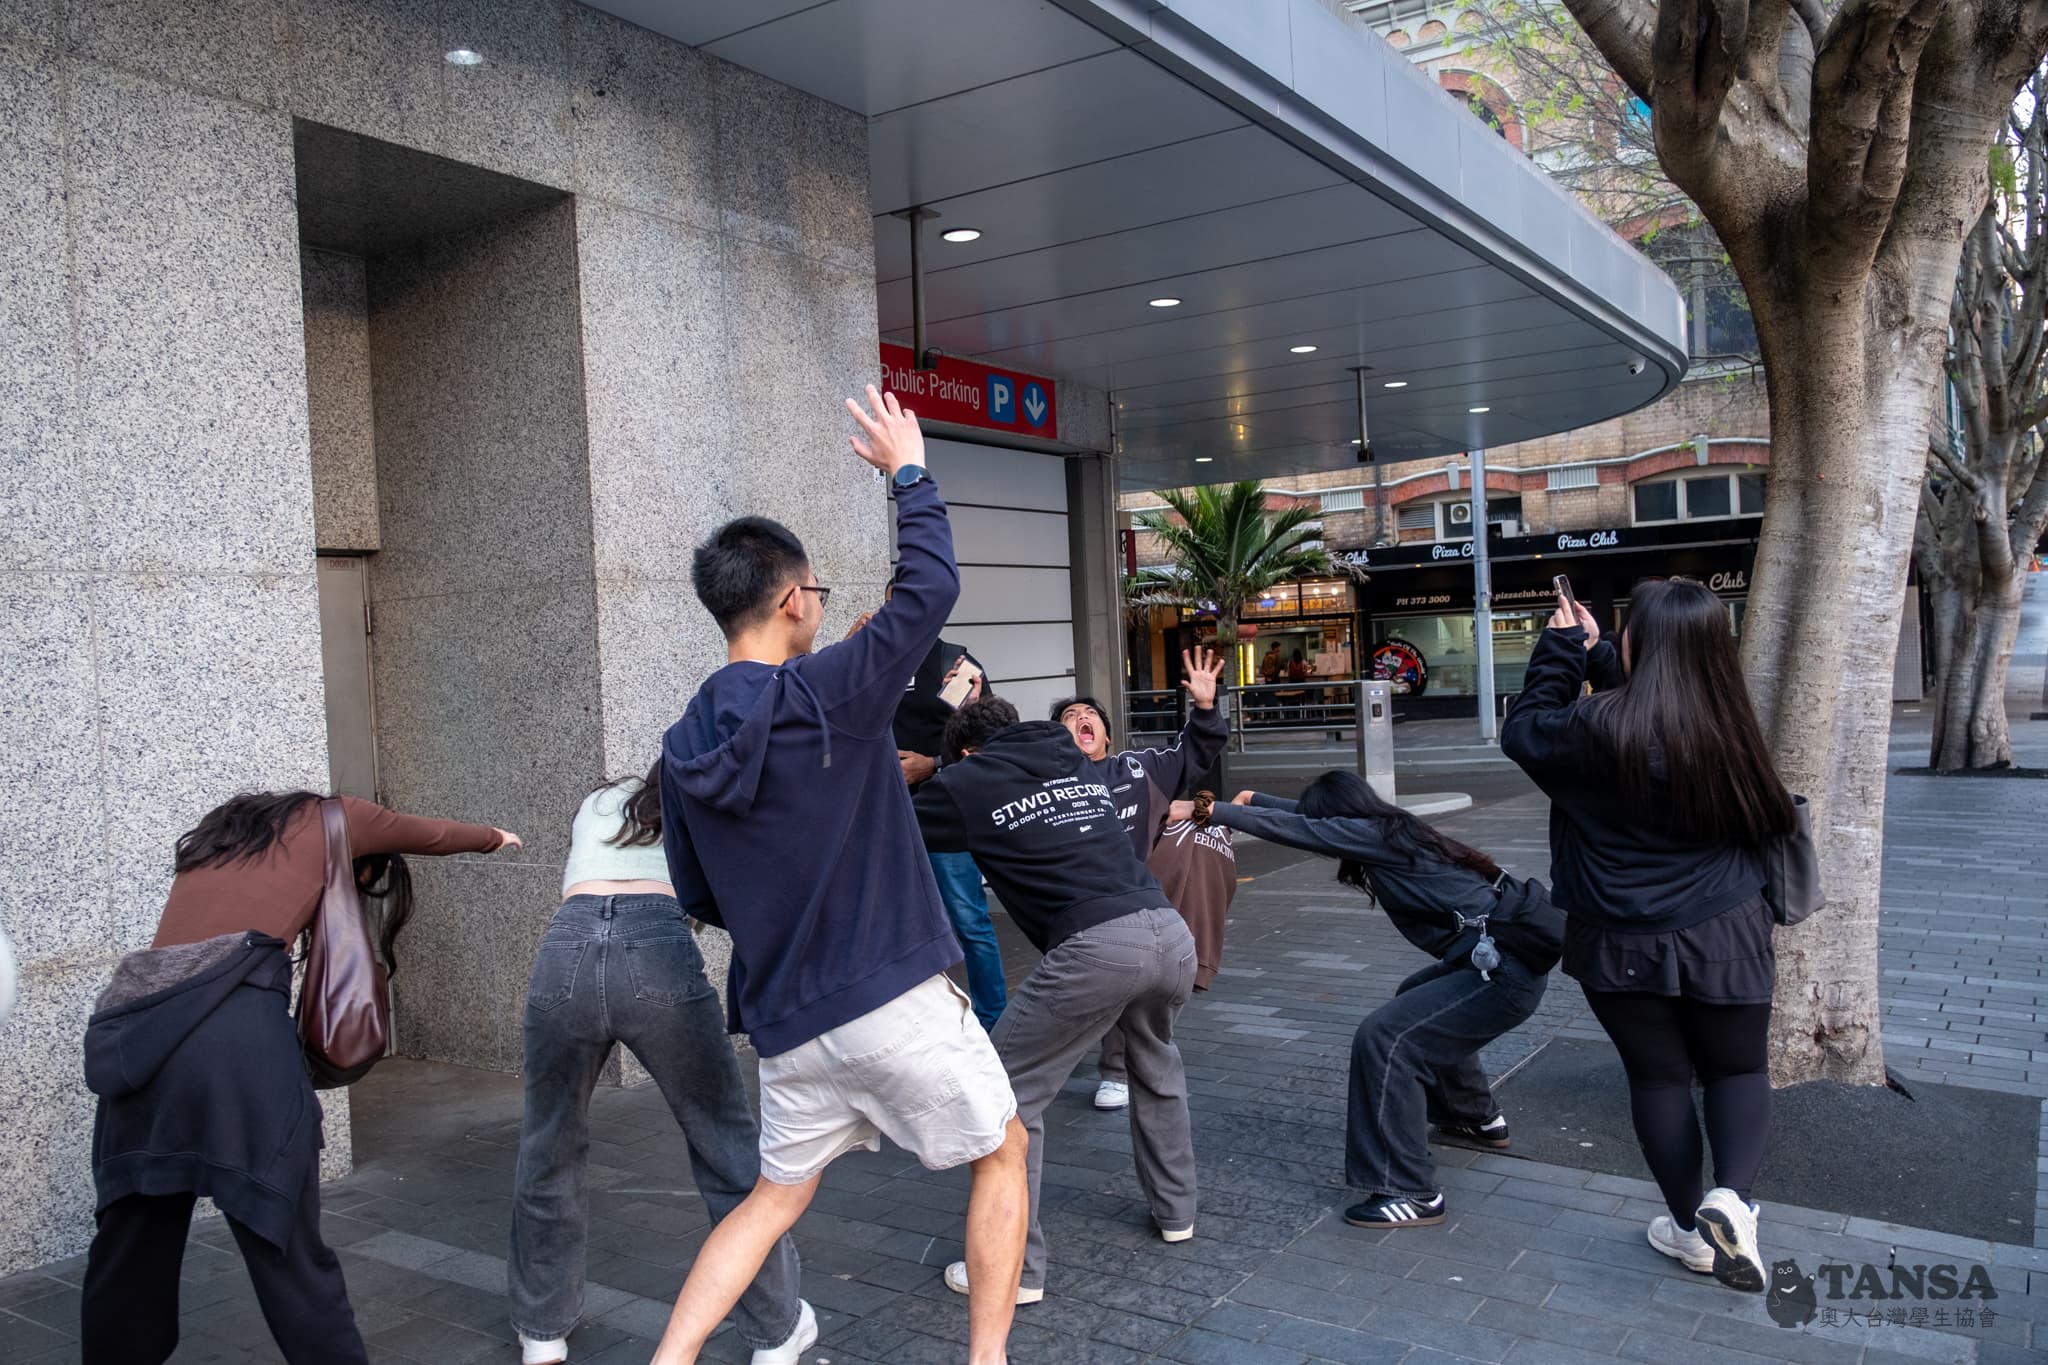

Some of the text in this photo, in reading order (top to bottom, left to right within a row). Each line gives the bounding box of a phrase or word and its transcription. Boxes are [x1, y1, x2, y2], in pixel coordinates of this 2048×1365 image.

[881, 363, 1009, 413] Public Parking P
[1557, 530, 1619, 550] Pizza Club
[1432, 545, 1460, 560] Pizza
[1709, 571, 1747, 591] Club
[1396, 594, 1451, 606] PH 373 3000
[991, 791, 1052, 826] STWD
